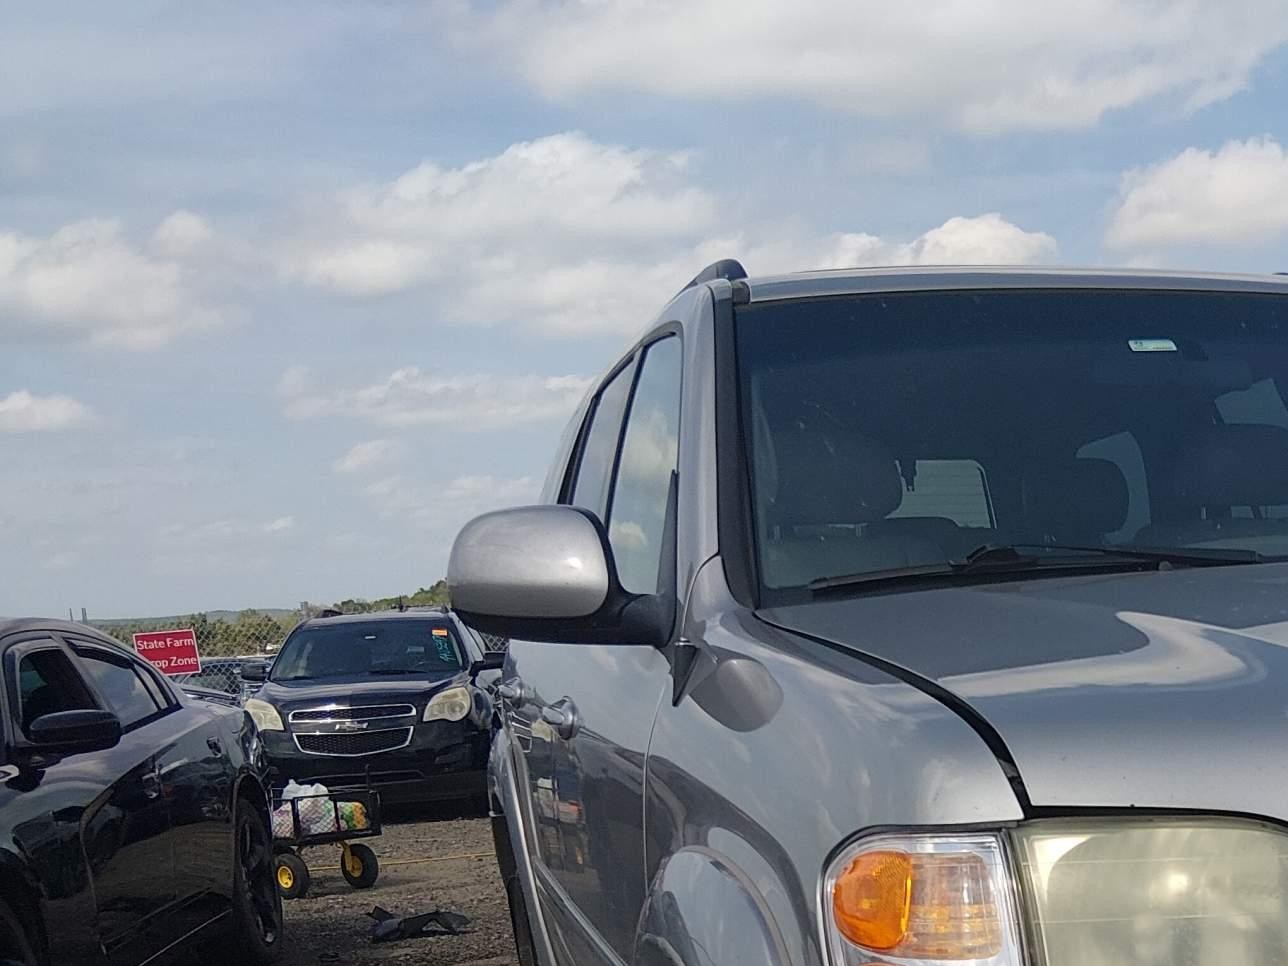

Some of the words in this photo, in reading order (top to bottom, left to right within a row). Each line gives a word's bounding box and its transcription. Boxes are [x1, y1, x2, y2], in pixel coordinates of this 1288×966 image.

[137, 639, 165, 650] State
[166, 637, 194, 648] Farm
[169, 656, 197, 666] Zone
